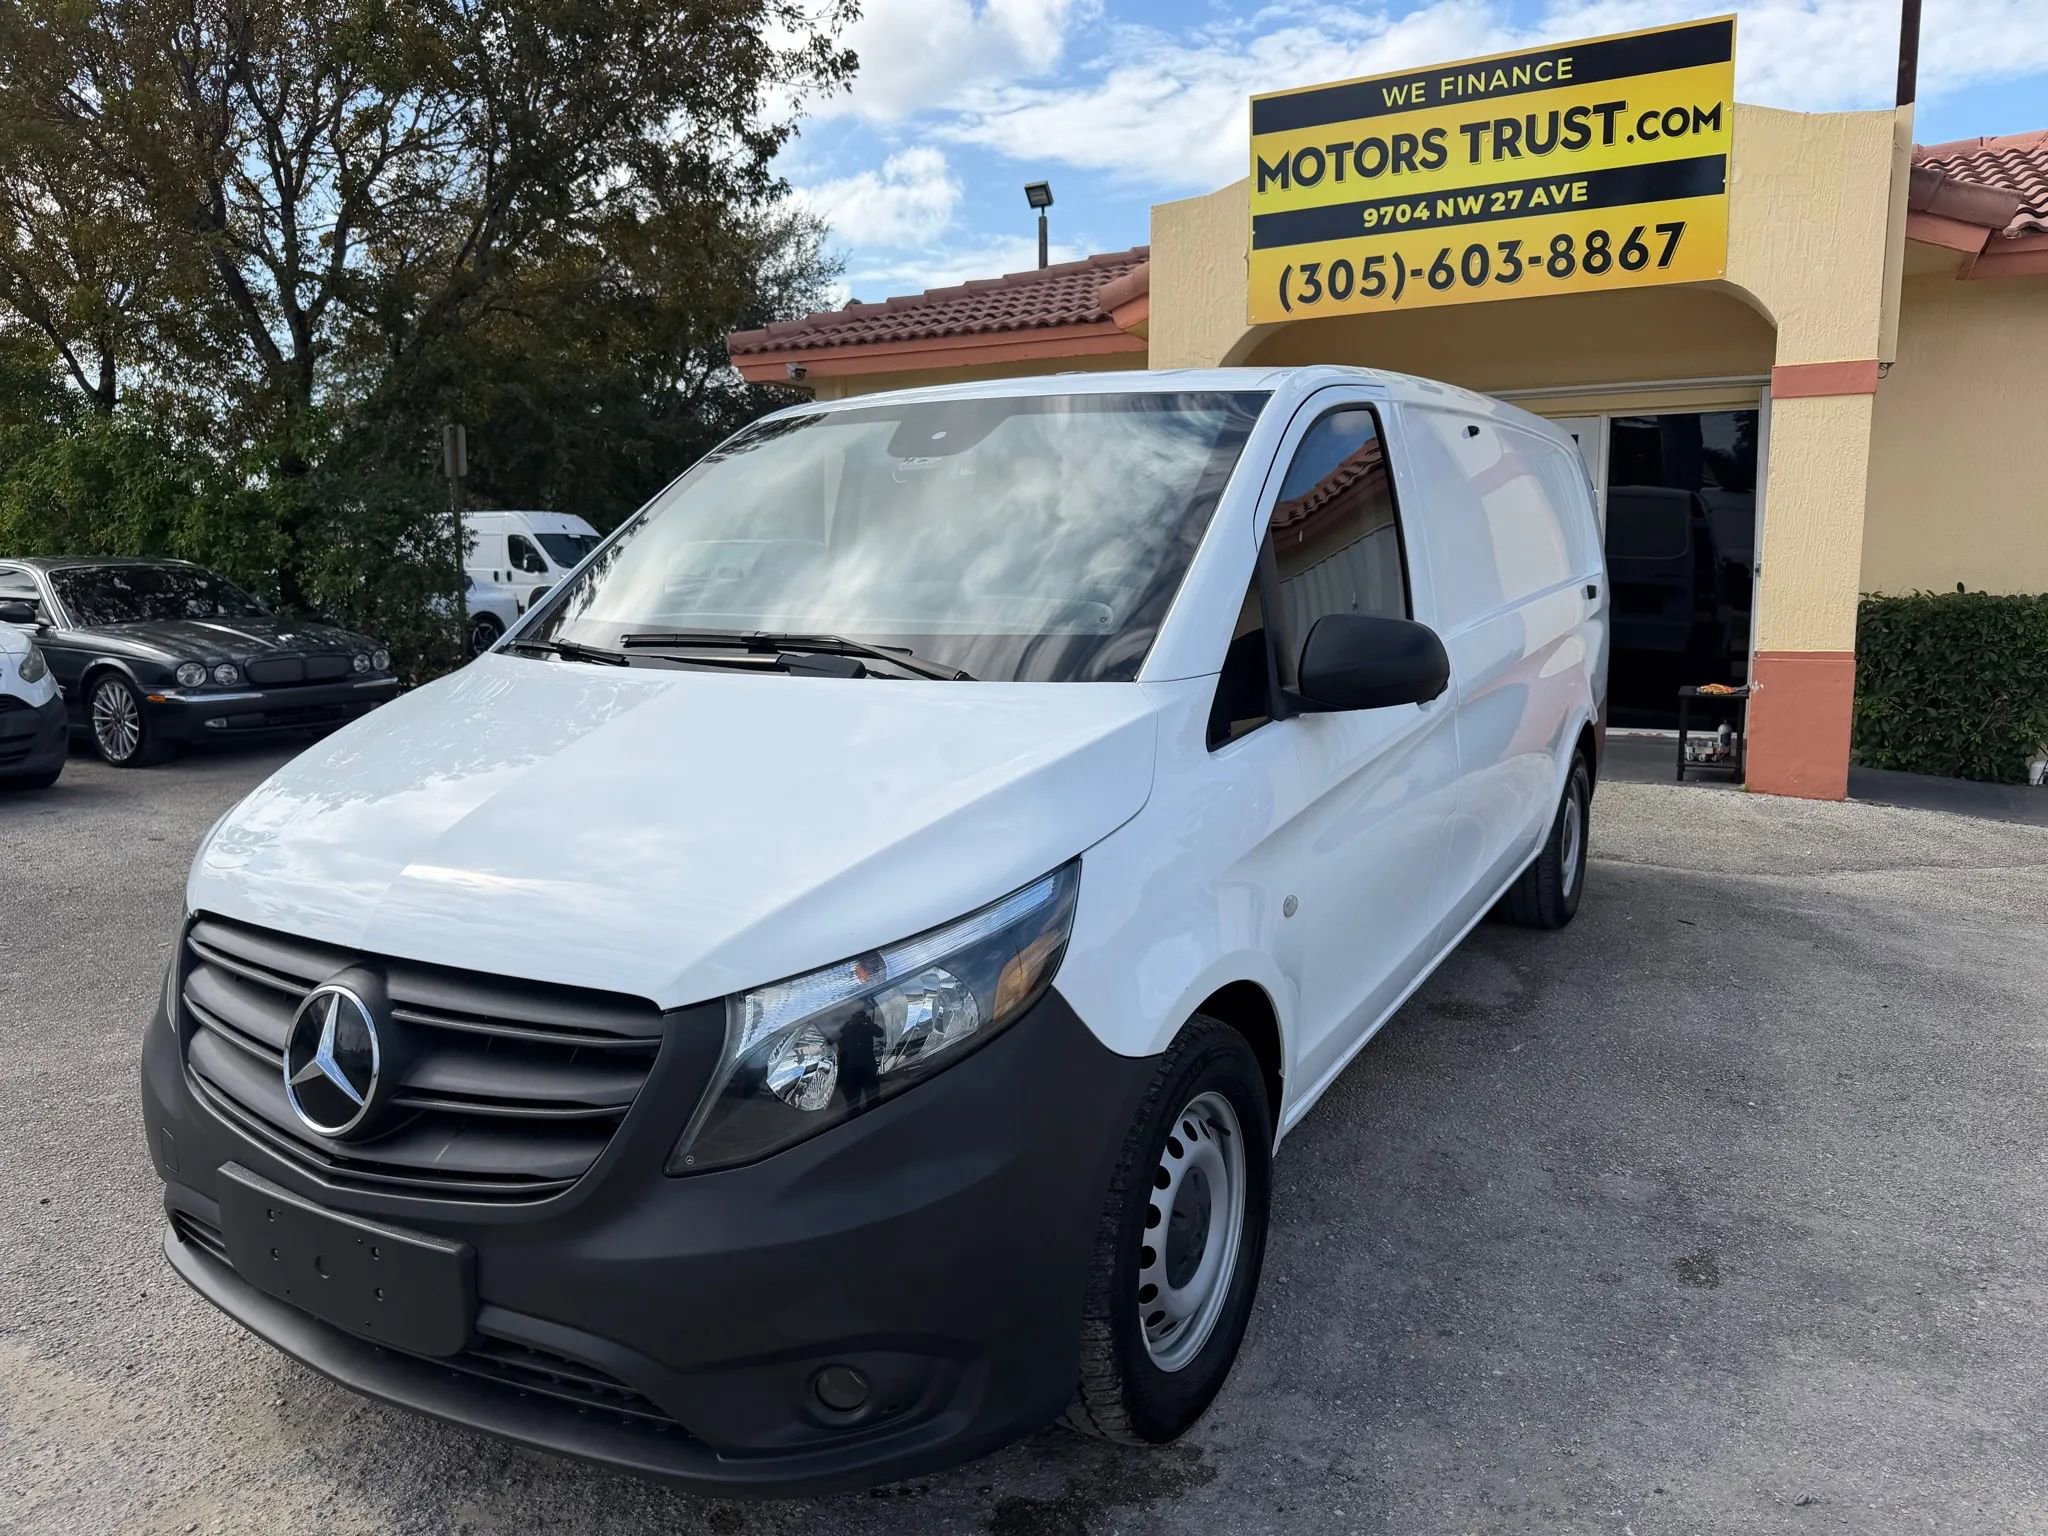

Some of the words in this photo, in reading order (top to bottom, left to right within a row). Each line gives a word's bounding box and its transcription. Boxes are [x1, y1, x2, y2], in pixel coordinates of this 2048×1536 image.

[1382, 82, 1426, 107] WE
[1441, 57, 1574, 97] FINANCE
[1257, 127, 1448, 194] MOTORS
[1363, 202, 1430, 228] 9704
[1436, 195, 1486, 219] NW
[1491, 190, 1524, 213] 27
[1529, 181, 1588, 206] AVE
[1278, 221, 1687, 314] (305)-603-8867
